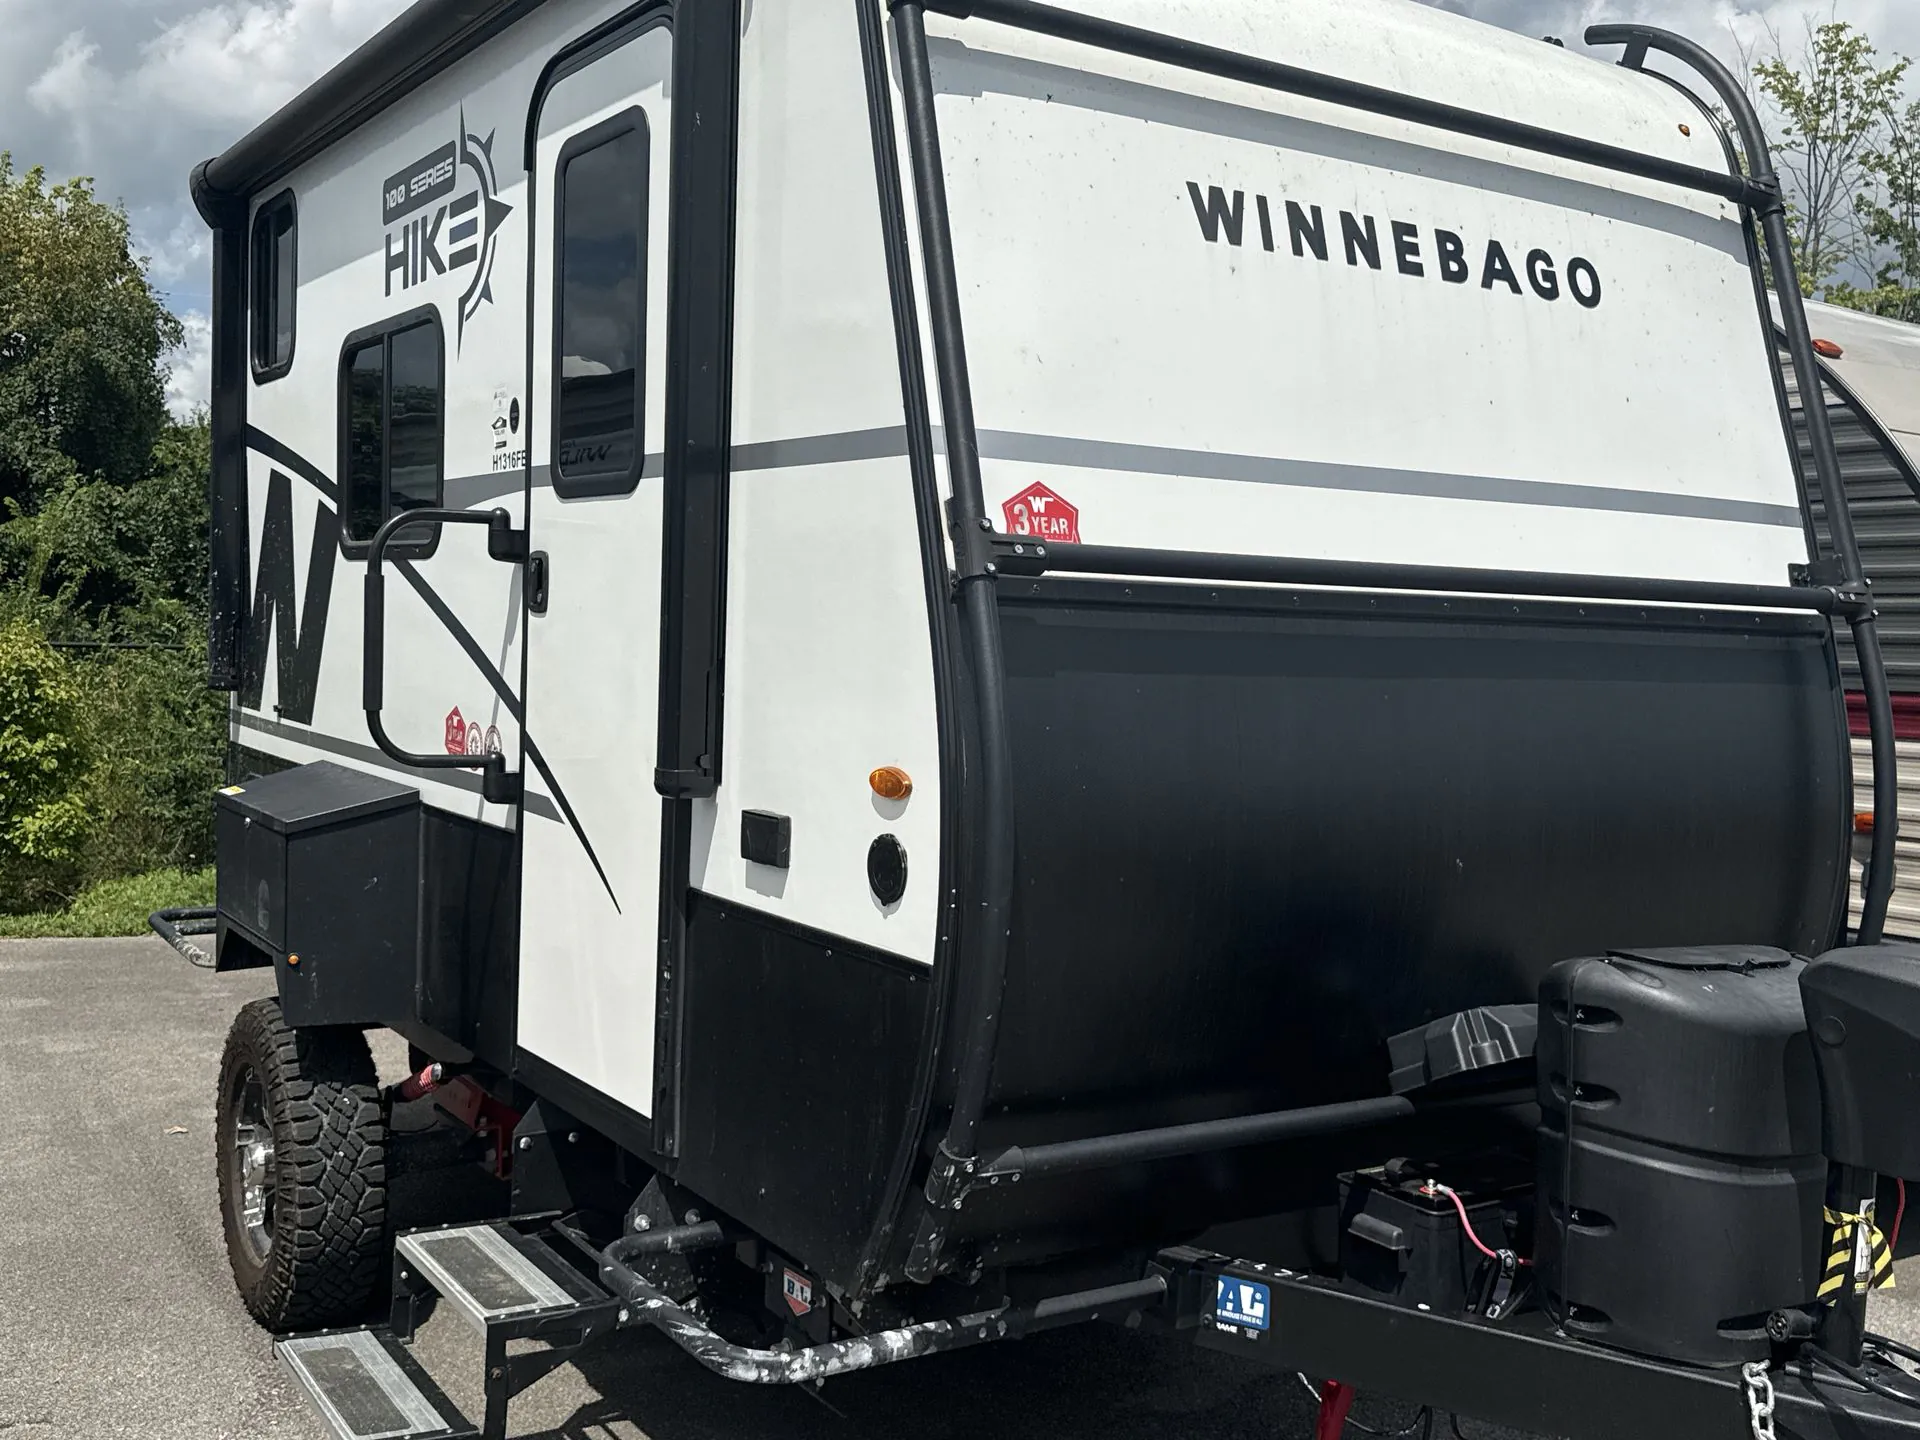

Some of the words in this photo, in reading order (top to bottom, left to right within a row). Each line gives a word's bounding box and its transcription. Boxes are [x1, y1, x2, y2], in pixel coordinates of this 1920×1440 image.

[386, 184, 406, 211] 100
[410, 157, 453, 198] SERIES
[385, 190, 478, 298] HIKE
[1186, 181, 1601, 309] WINNEBAGO
[1013, 503, 1029, 536] 3
[1031, 516, 1069, 535] YEAR
